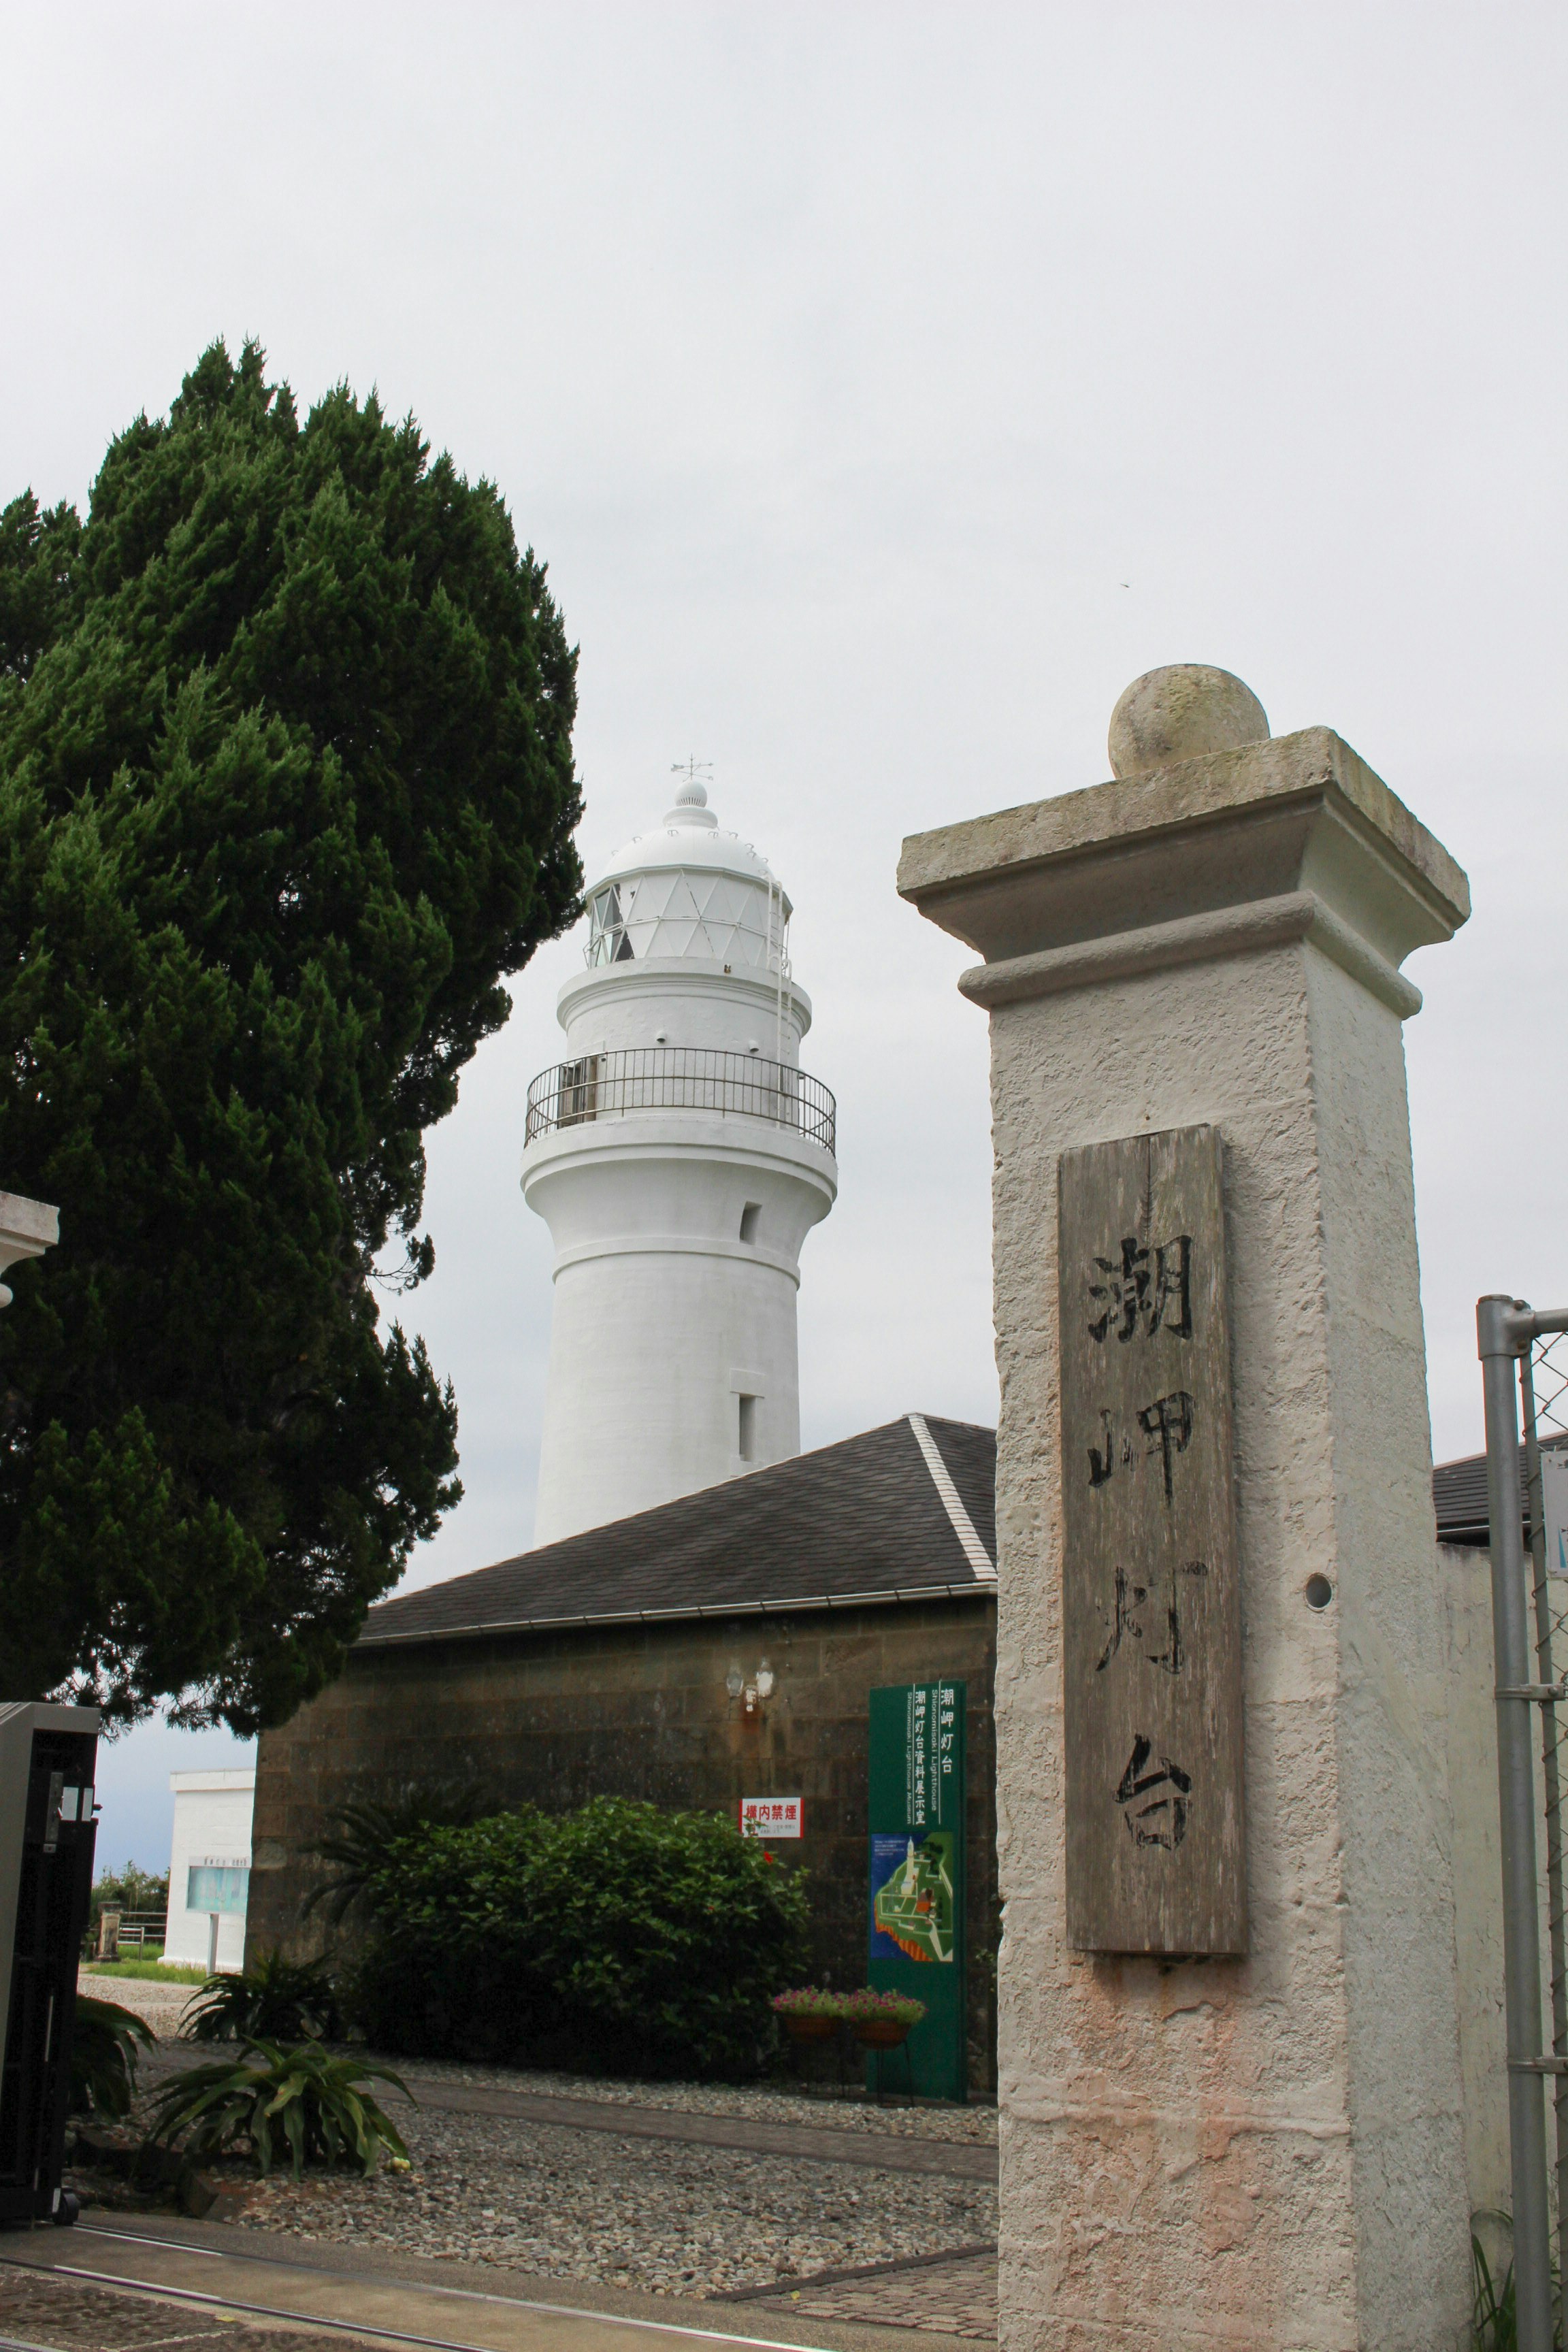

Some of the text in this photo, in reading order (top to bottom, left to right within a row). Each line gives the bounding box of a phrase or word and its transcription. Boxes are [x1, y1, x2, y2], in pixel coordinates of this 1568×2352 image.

[1089, 1235, 1208, 1851] 潮岬灯台
[915, 1690, 926, 1825] 潮岬灯台資料展示室
[941, 1688, 954, 1774] 潮岬灯台
[746, 1804, 797, 1820] 構内禁煙
[930, 1756, 938, 1811] Lighthouse
